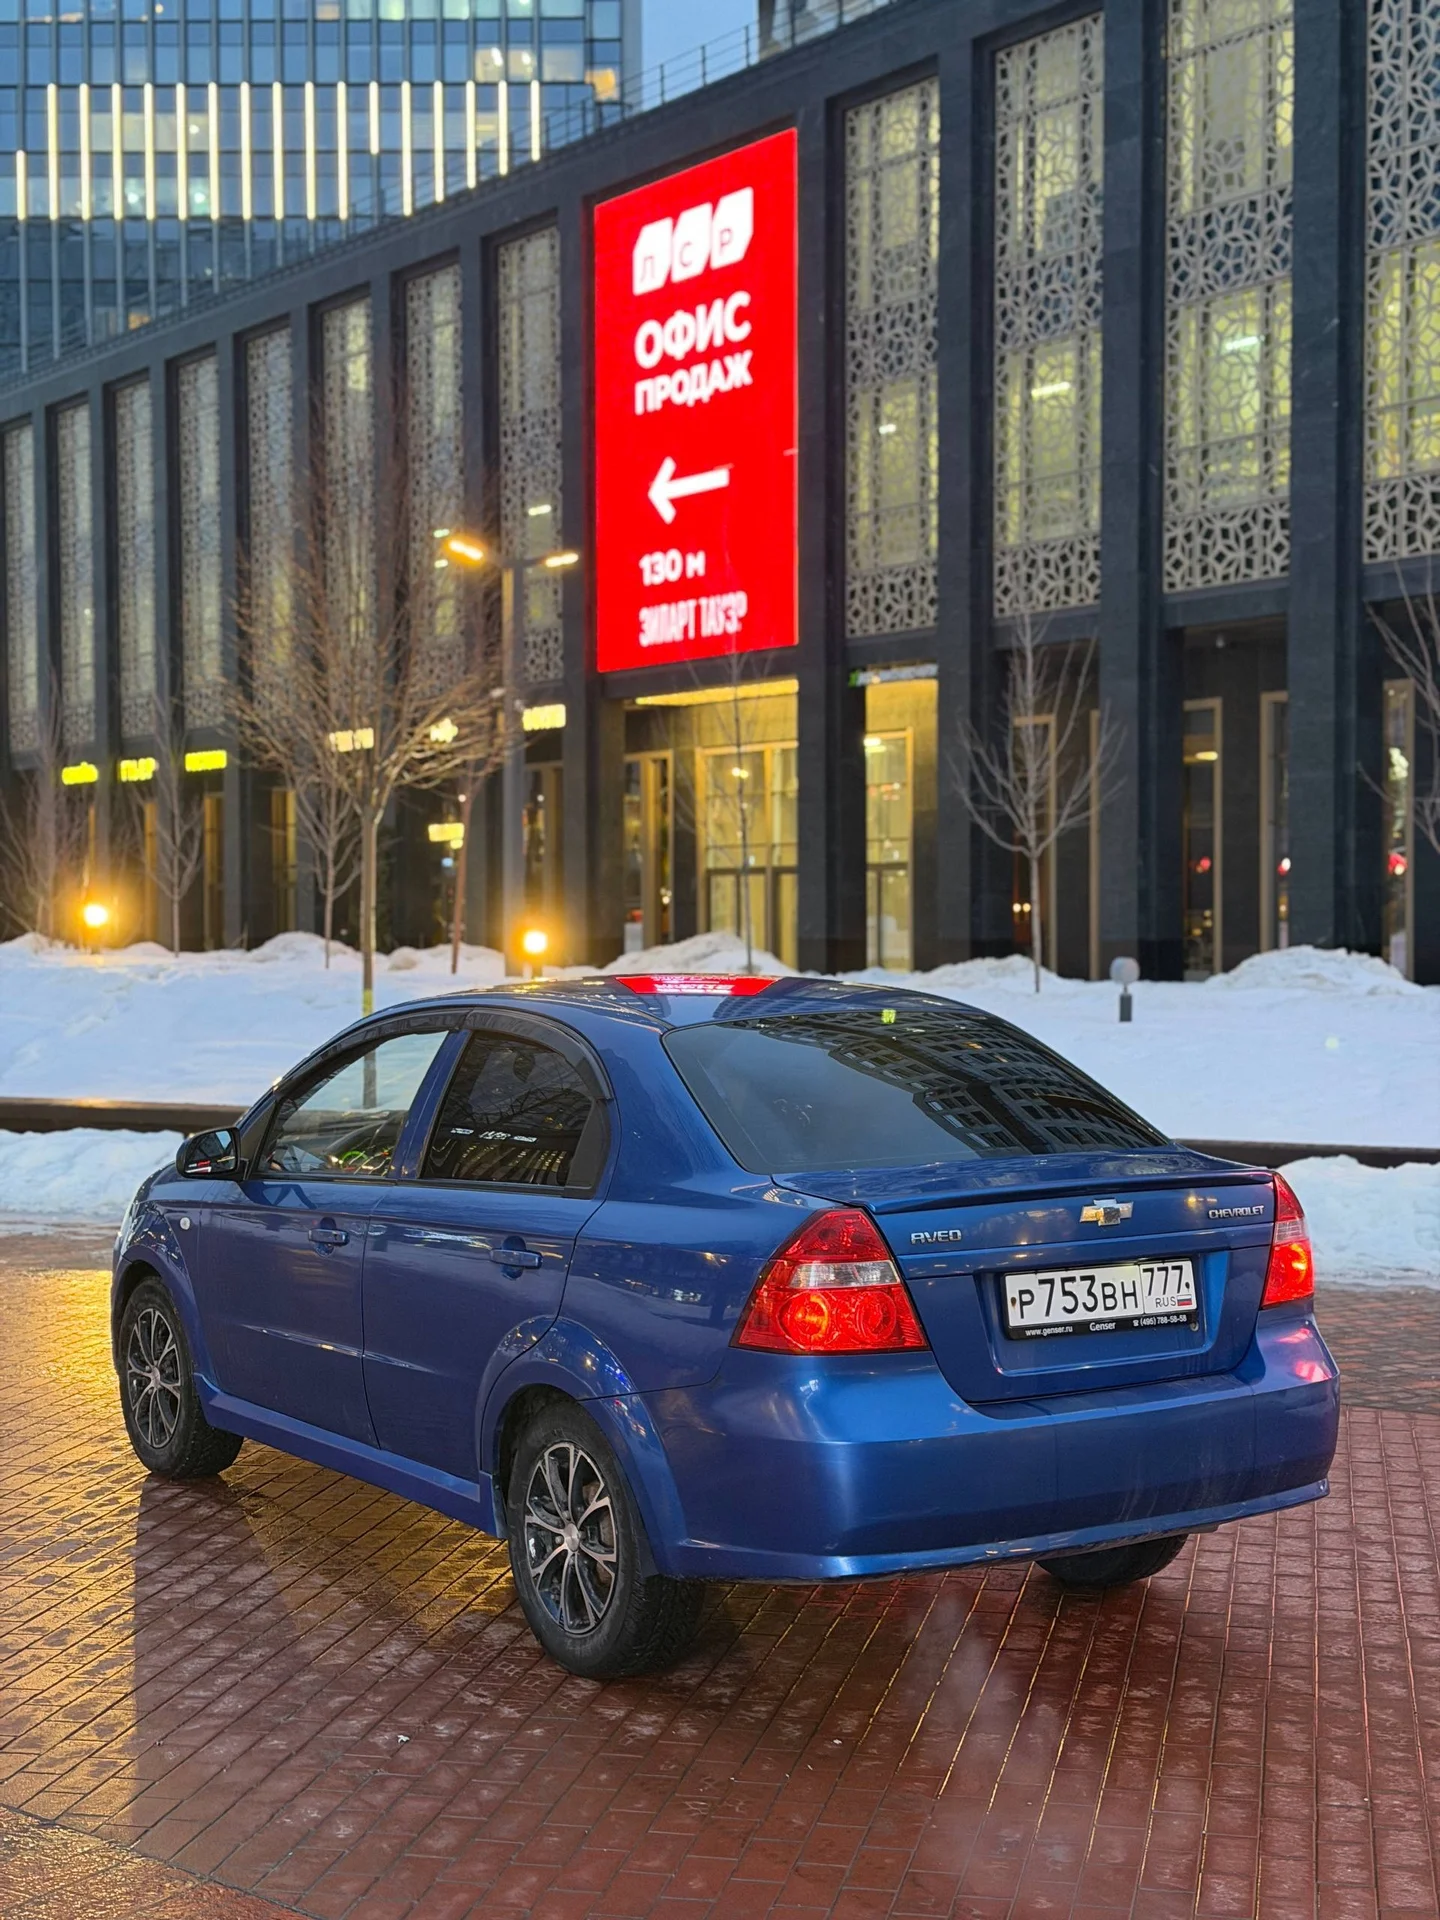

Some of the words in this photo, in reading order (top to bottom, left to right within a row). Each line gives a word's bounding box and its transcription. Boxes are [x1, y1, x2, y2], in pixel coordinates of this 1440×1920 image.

[634, 290, 752, 369] ОФИС
[634, 349, 753, 416] ПРОДАЖ
[638, 548, 683, 587] 130
[1208, 1205, 1265, 1219] CHEVROLET
[910, 1229, 962, 1245] AVEO
[1142, 1265, 1184, 1297] 777
[1155, 1296, 1177, 1308] RUS
[1025, 1325, 1073, 1337] www.genser.ru
[1089, 1321, 1117, 1332] Genser
